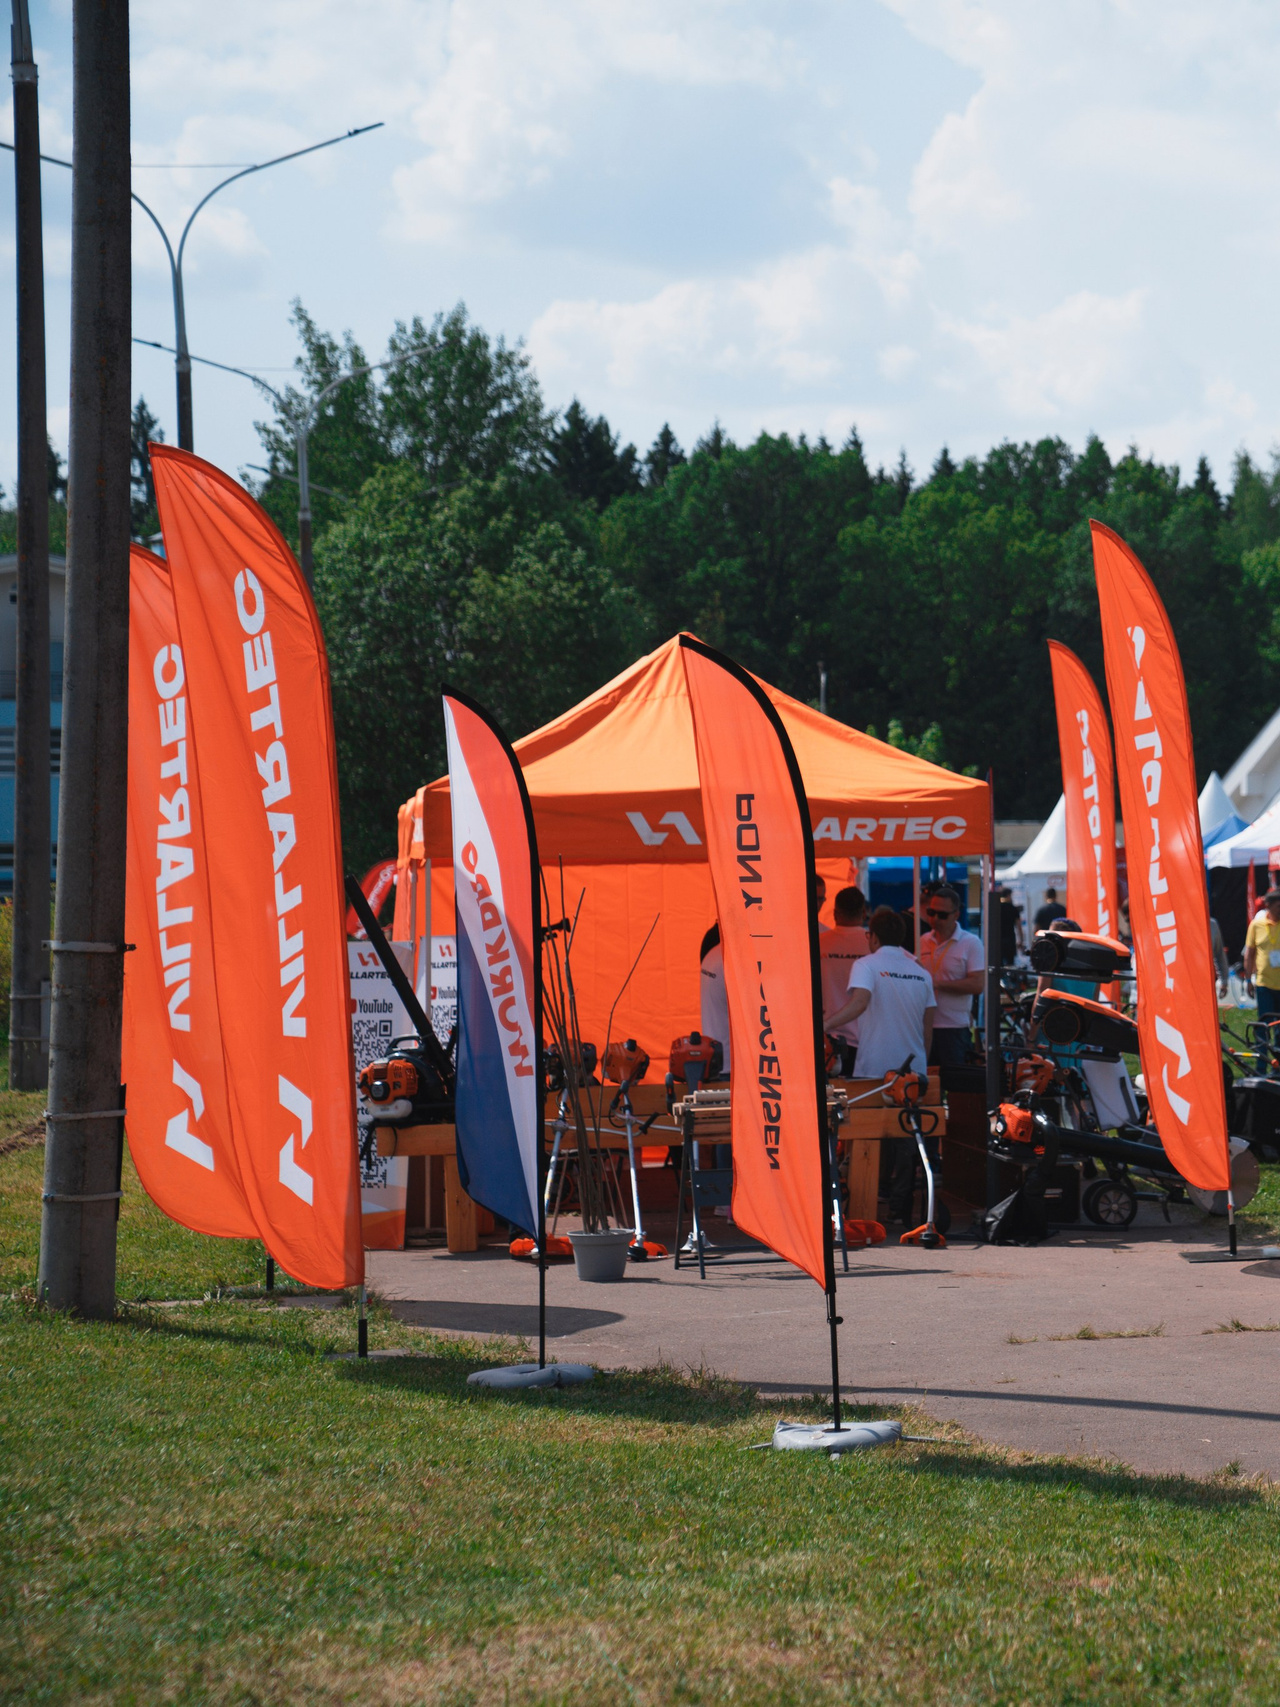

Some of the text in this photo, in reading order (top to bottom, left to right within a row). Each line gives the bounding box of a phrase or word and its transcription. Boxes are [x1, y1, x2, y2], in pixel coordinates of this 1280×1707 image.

[813, 816, 967, 841] ARTEC
[350, 971, 391, 979] LLARTE
[889, 972, 925, 982] VILLARTEC
[358, 999, 393, 1014] YouTube
